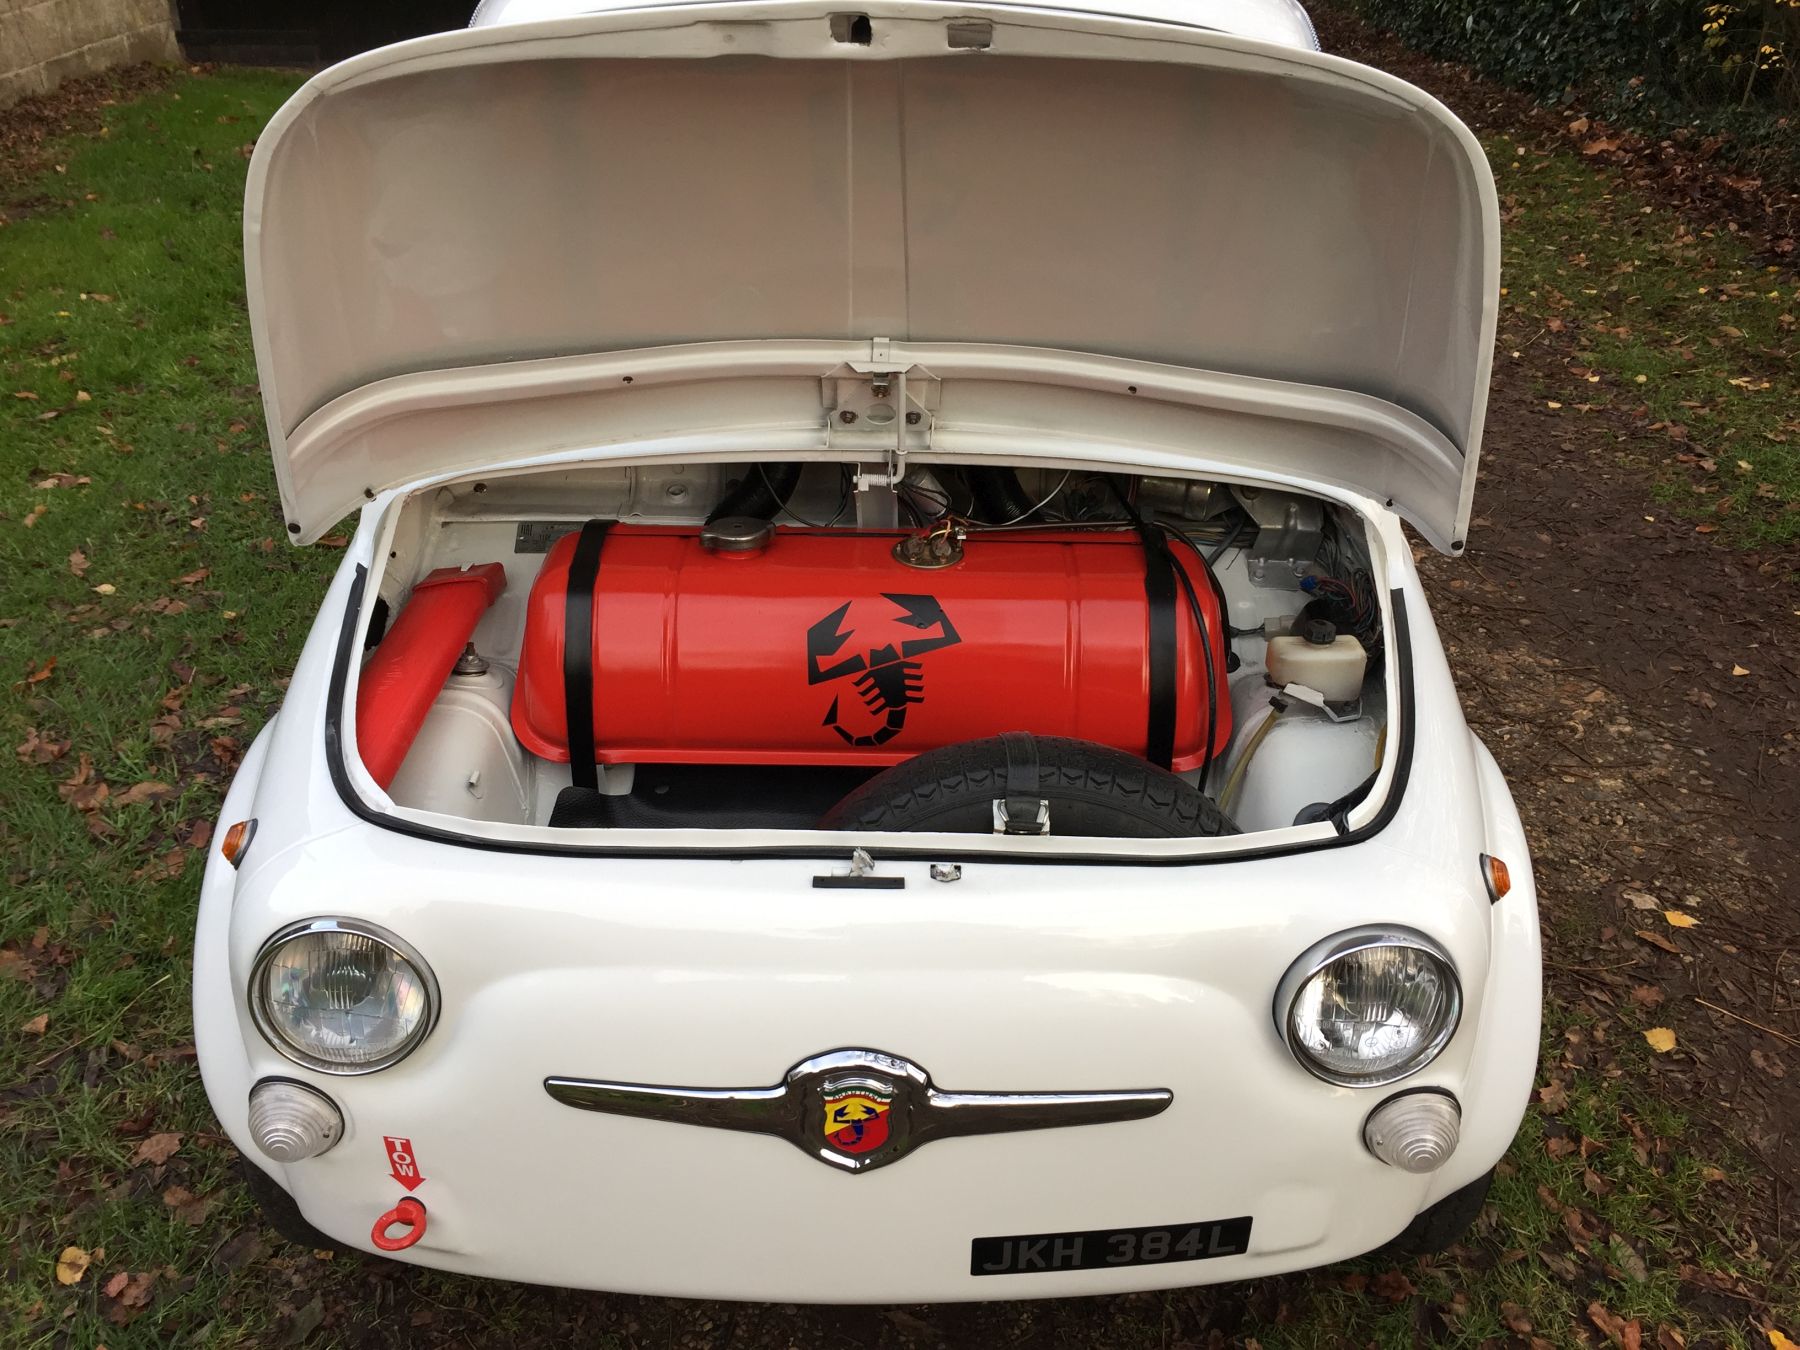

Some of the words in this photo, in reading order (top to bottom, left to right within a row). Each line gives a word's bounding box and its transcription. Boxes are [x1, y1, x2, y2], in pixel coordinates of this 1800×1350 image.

[387, 1138, 414, 1176] TOW
[982, 1237, 1083, 1271] JKH
[1105, 1225, 1236, 1263] 384L
